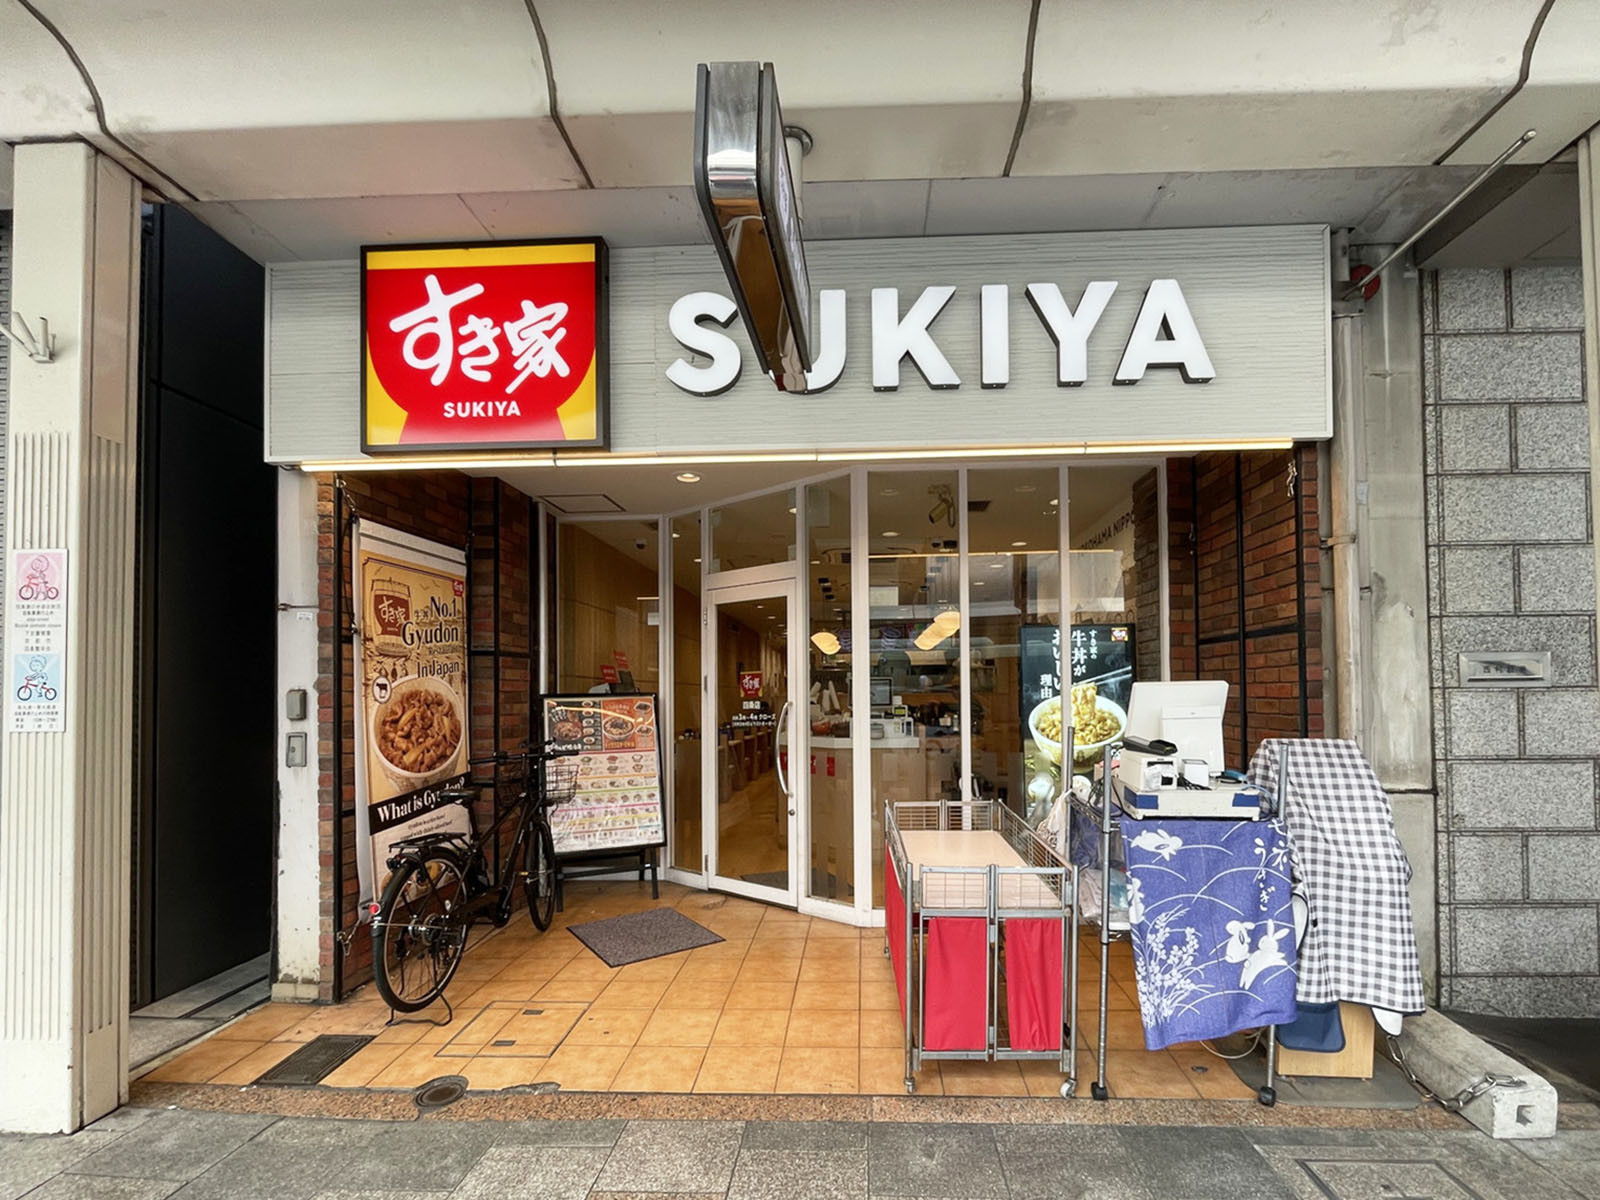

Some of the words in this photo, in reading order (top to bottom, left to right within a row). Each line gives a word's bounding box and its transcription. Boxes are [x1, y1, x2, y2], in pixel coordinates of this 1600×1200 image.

[389, 273, 571, 395] すき家
[443, 400, 521, 418] SUKIYA
[378, 596, 407, 627] すき家
[430, 595, 457, 617] No.1
[402, 621, 459, 650] Gyudon
[1071, 629, 1088, 677] 牛丼が
[427, 660, 460, 679] Japan
[1040, 674, 1053, 698] 理由
[377, 800, 412, 823] What
[413, 795, 423, 811] is
